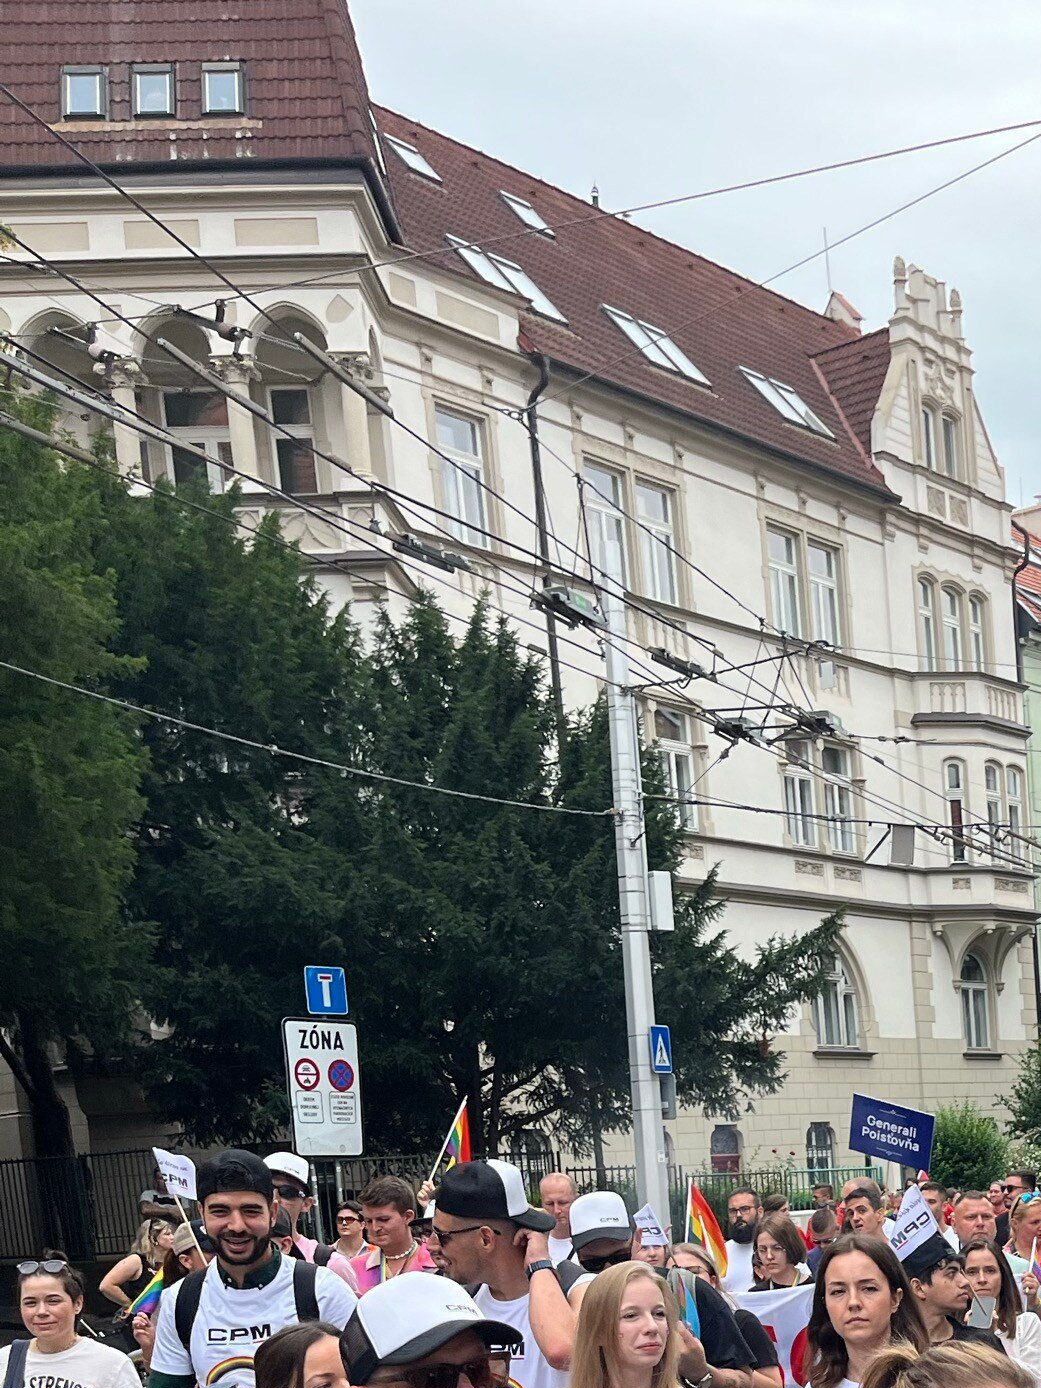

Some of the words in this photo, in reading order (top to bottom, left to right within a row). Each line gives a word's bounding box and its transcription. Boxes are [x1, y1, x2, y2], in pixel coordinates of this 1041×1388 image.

[298, 1024, 345, 1051] ZÓNA
[861, 1125, 920, 1152] Poisťovňa
[866, 1115, 917, 1139] Generali
[445, 1304, 479, 1319] CPM
[207, 1324, 272, 1342] CPM
